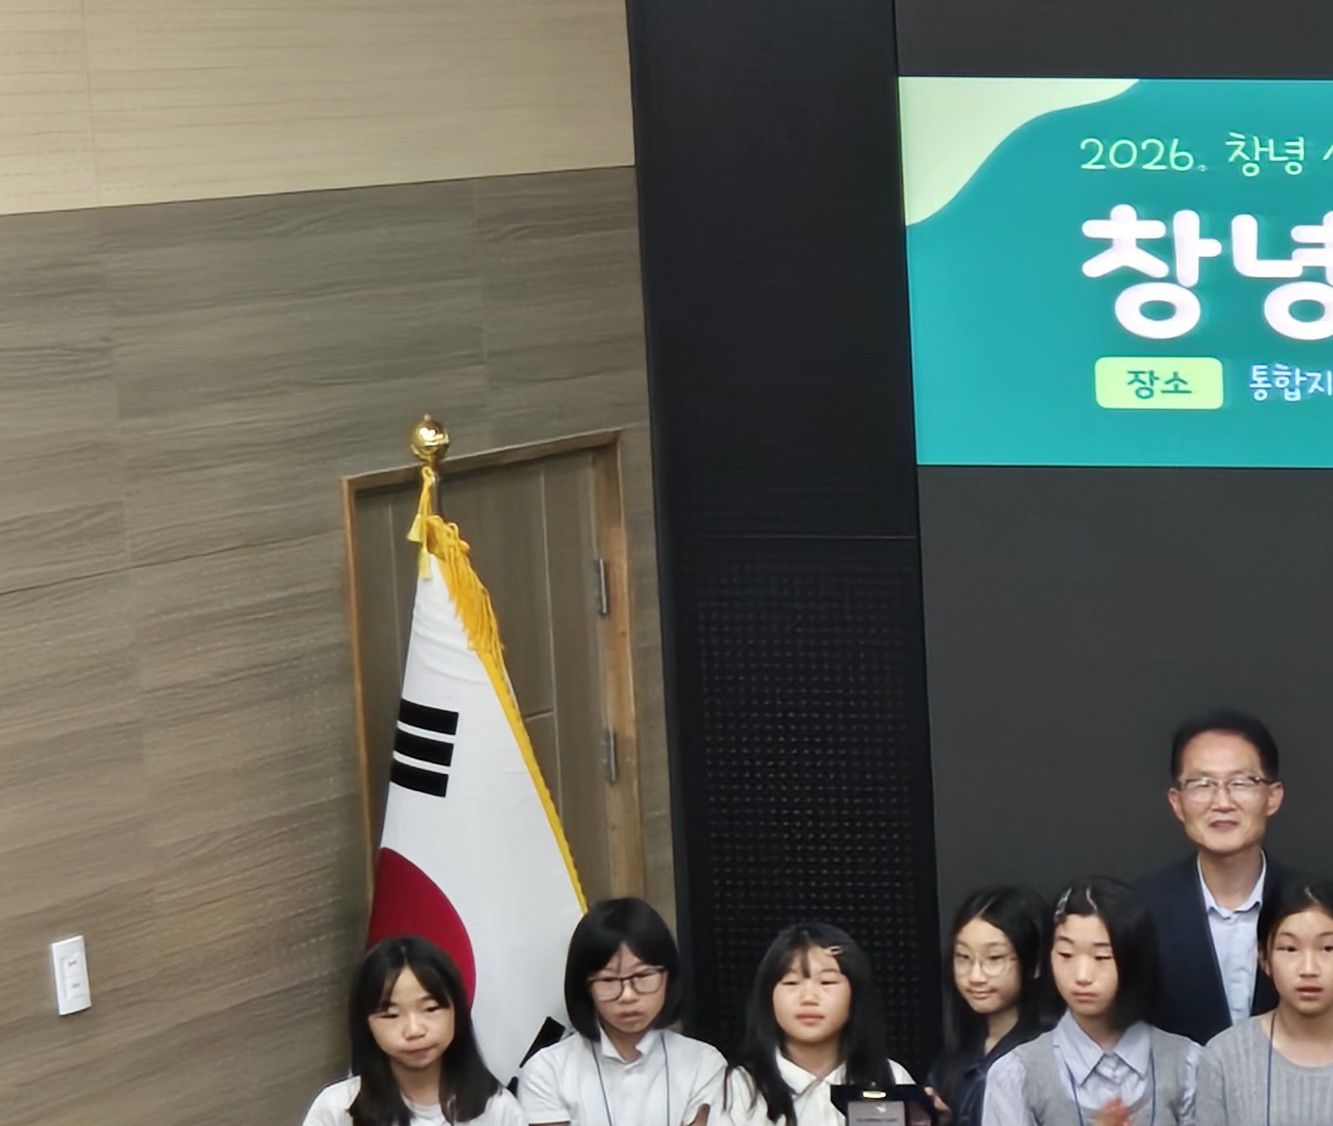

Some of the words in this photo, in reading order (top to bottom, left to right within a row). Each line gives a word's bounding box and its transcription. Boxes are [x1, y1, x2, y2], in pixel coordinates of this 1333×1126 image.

[1080, 136, 1208, 173] 2026.
[1225, 131, 1306, 178] 창녕
[1126, 369, 1193, 400] 장소
